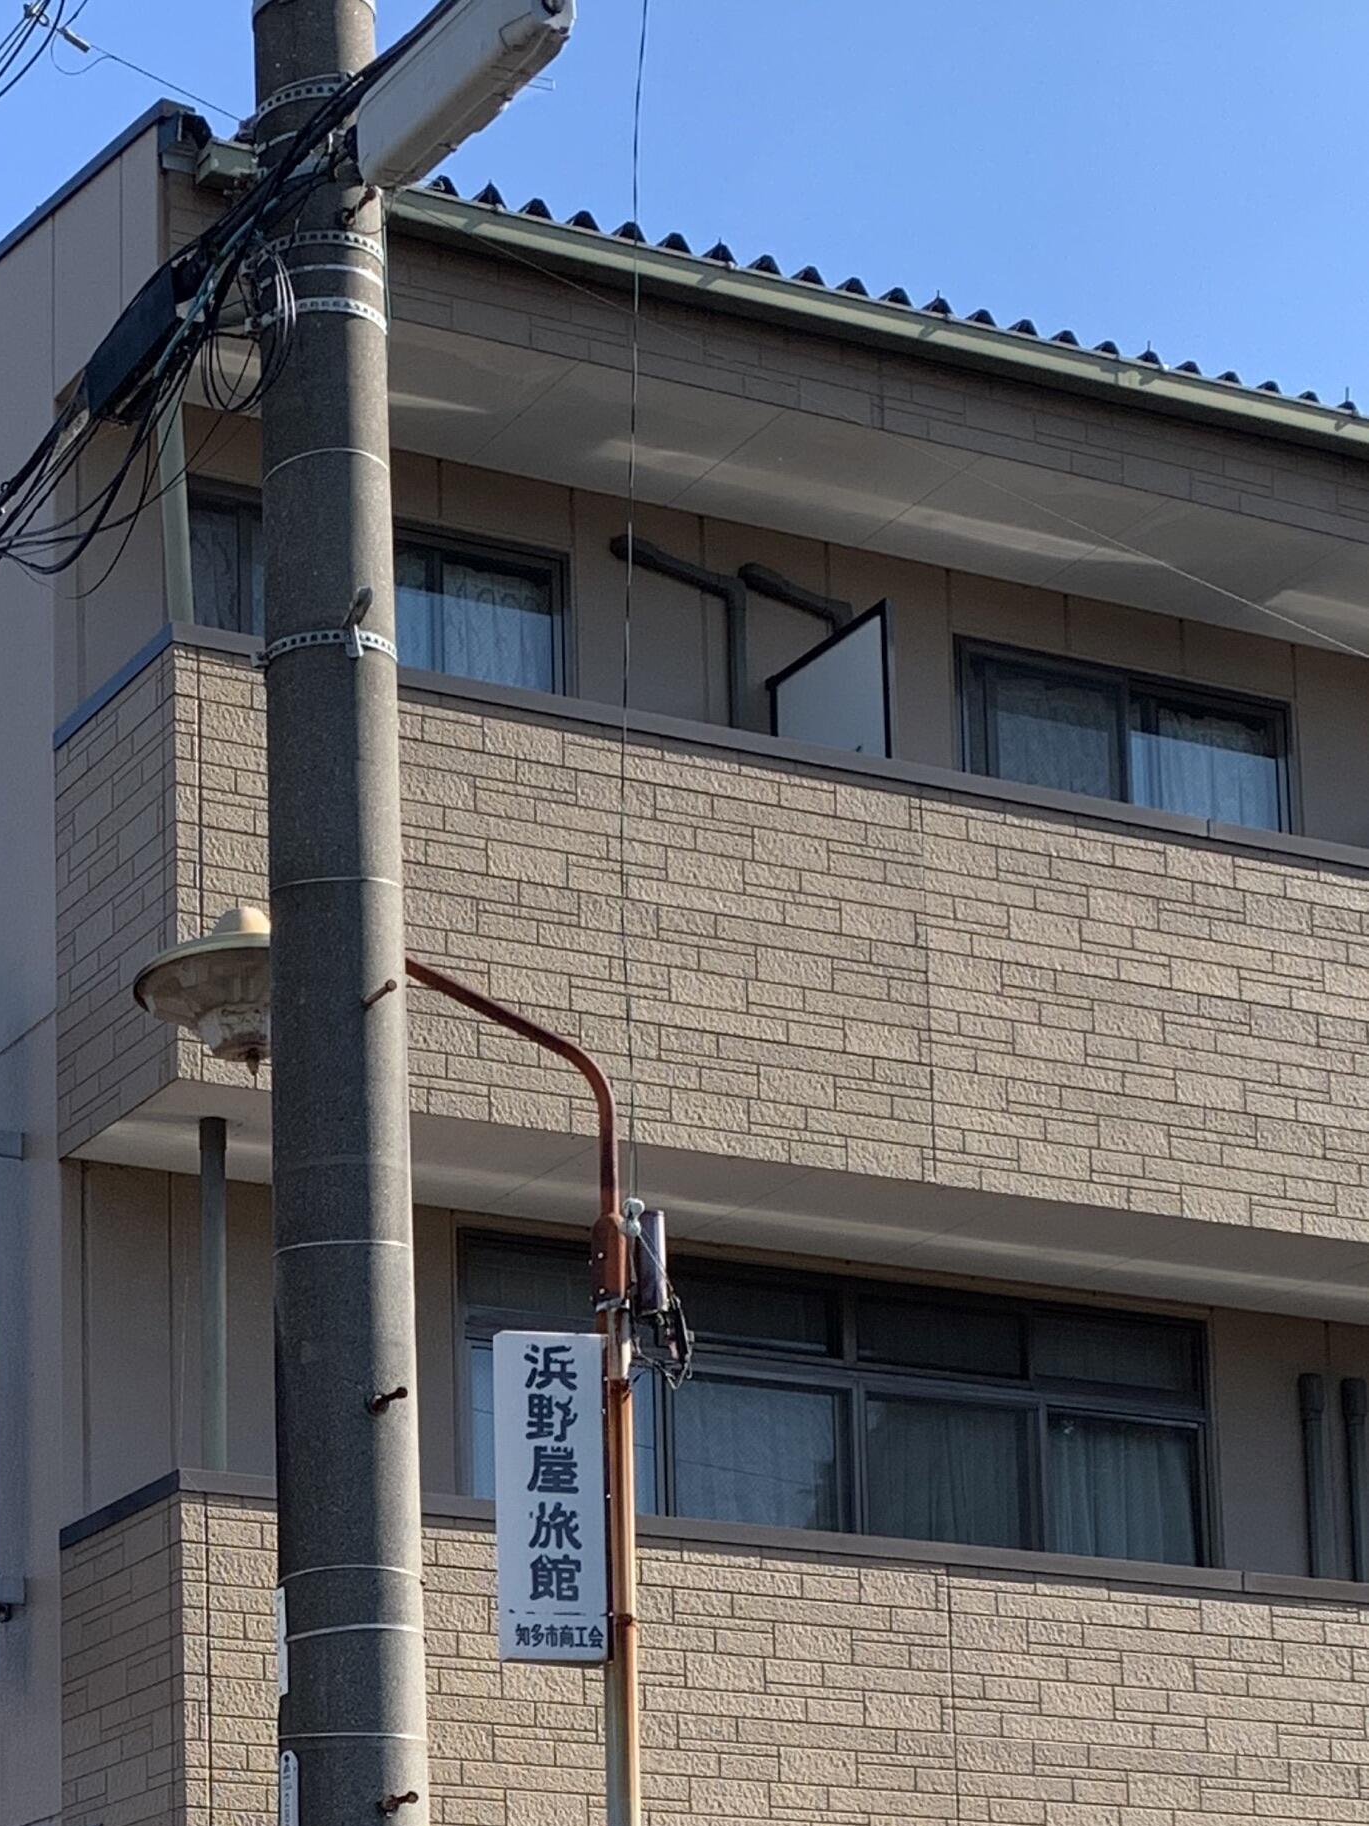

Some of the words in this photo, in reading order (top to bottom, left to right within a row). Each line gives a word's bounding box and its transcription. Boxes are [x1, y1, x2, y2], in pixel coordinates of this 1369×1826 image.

[523, 1343, 583, 1602] 浜野屋旅館
[515, 1623, 605, 1650] 知多市商工会
